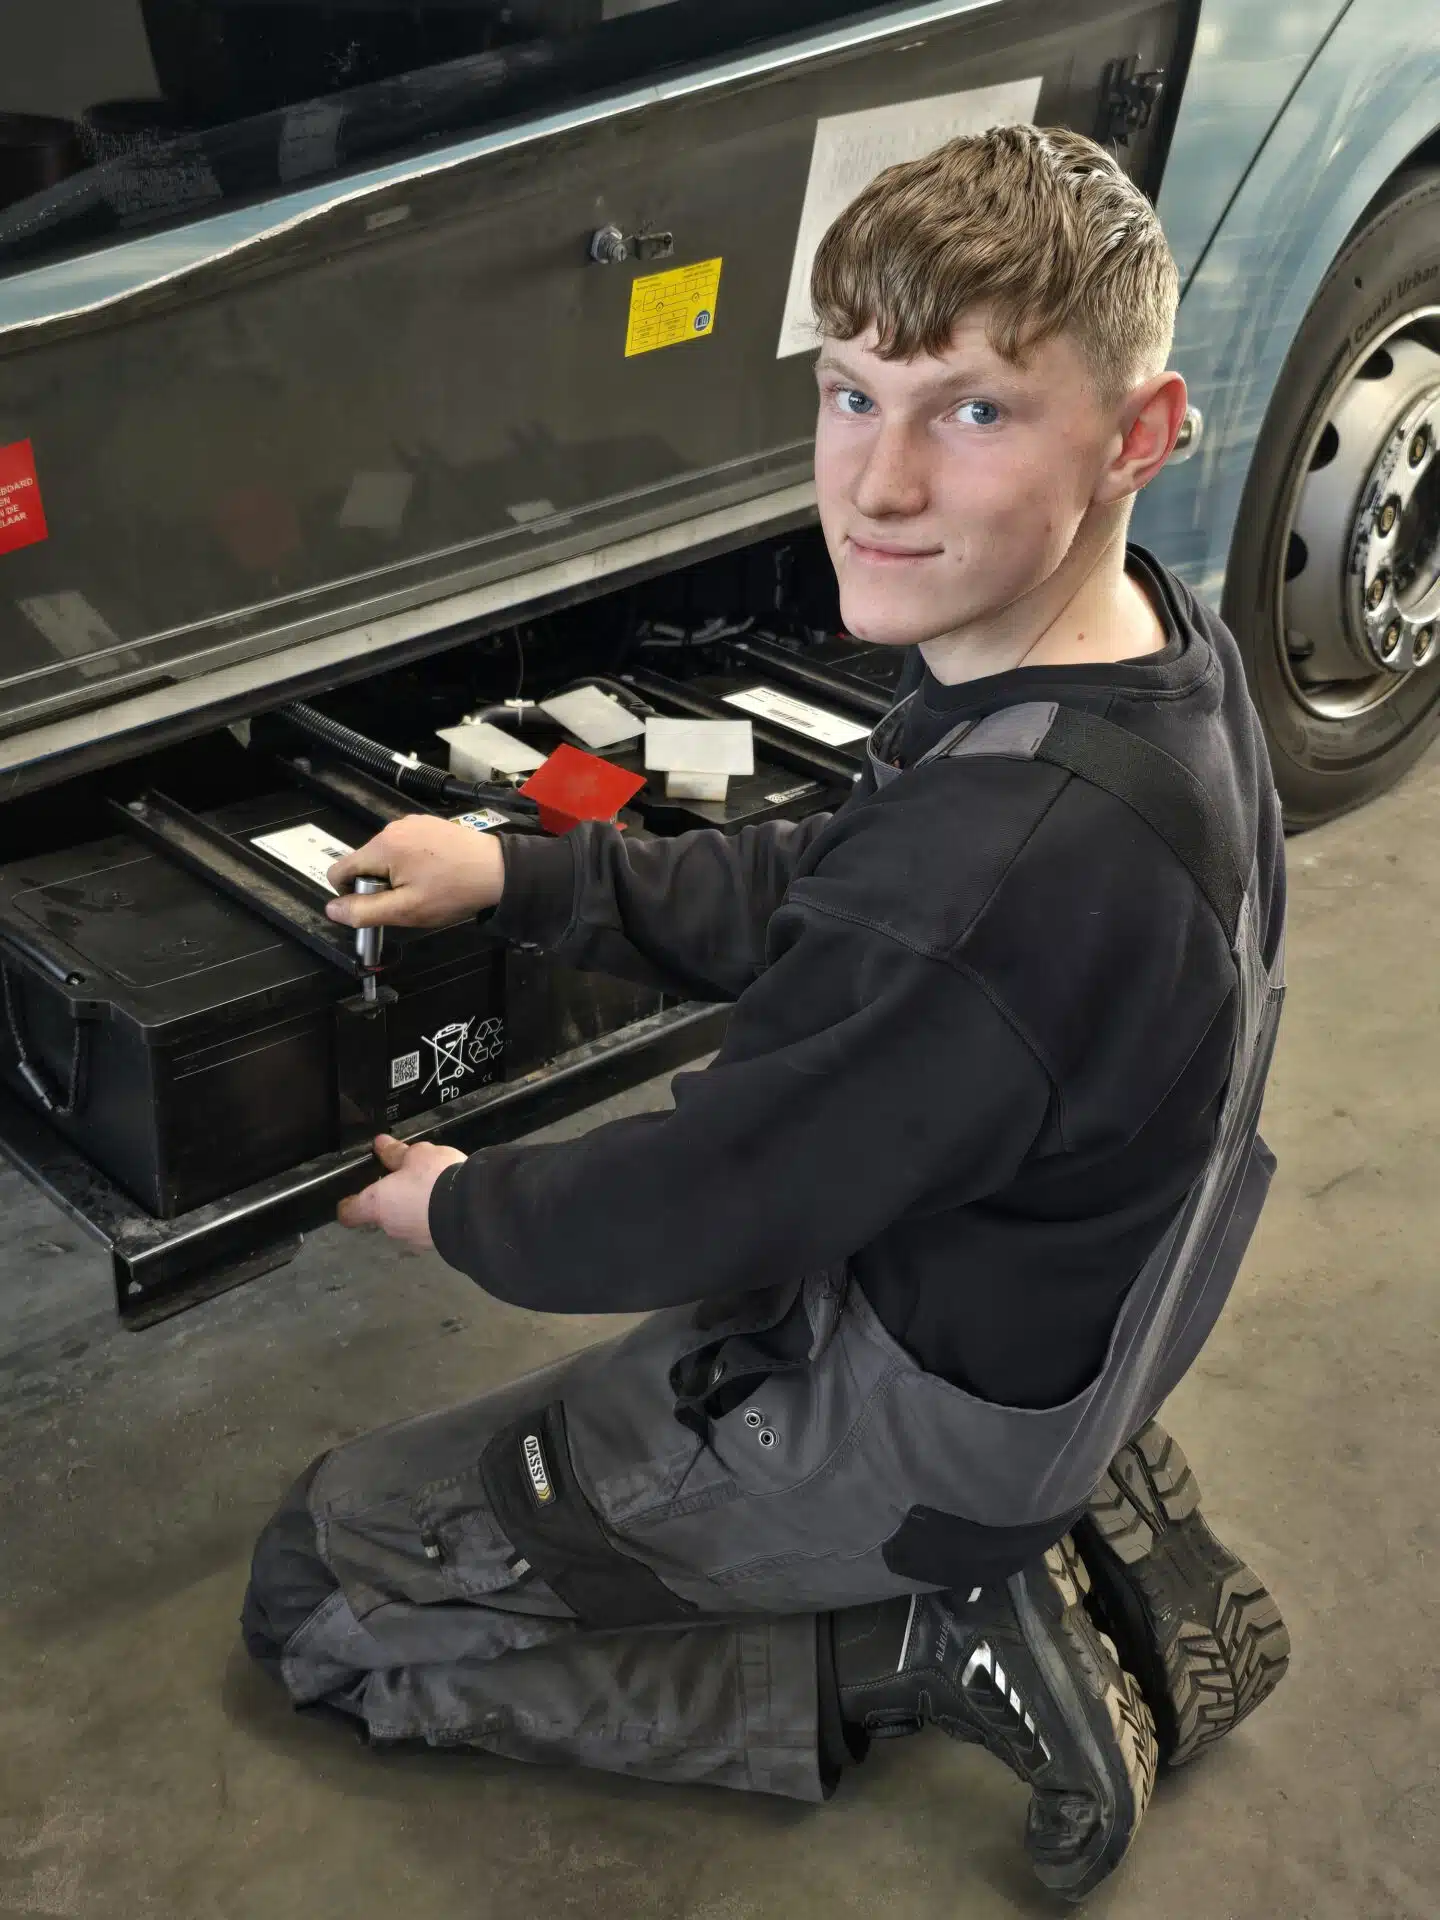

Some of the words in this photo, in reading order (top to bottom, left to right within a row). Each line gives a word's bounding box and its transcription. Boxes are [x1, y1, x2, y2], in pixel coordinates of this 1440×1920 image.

[1355, 288, 1392, 343] Conti
[1397, 265, 1439, 298] Urban
[0, 477, 33, 497] BOARD
[5, 504, 20, 515] DE
[441, 1085, 460, 1103] Pb
[525, 1439, 546, 1485] DASSY
